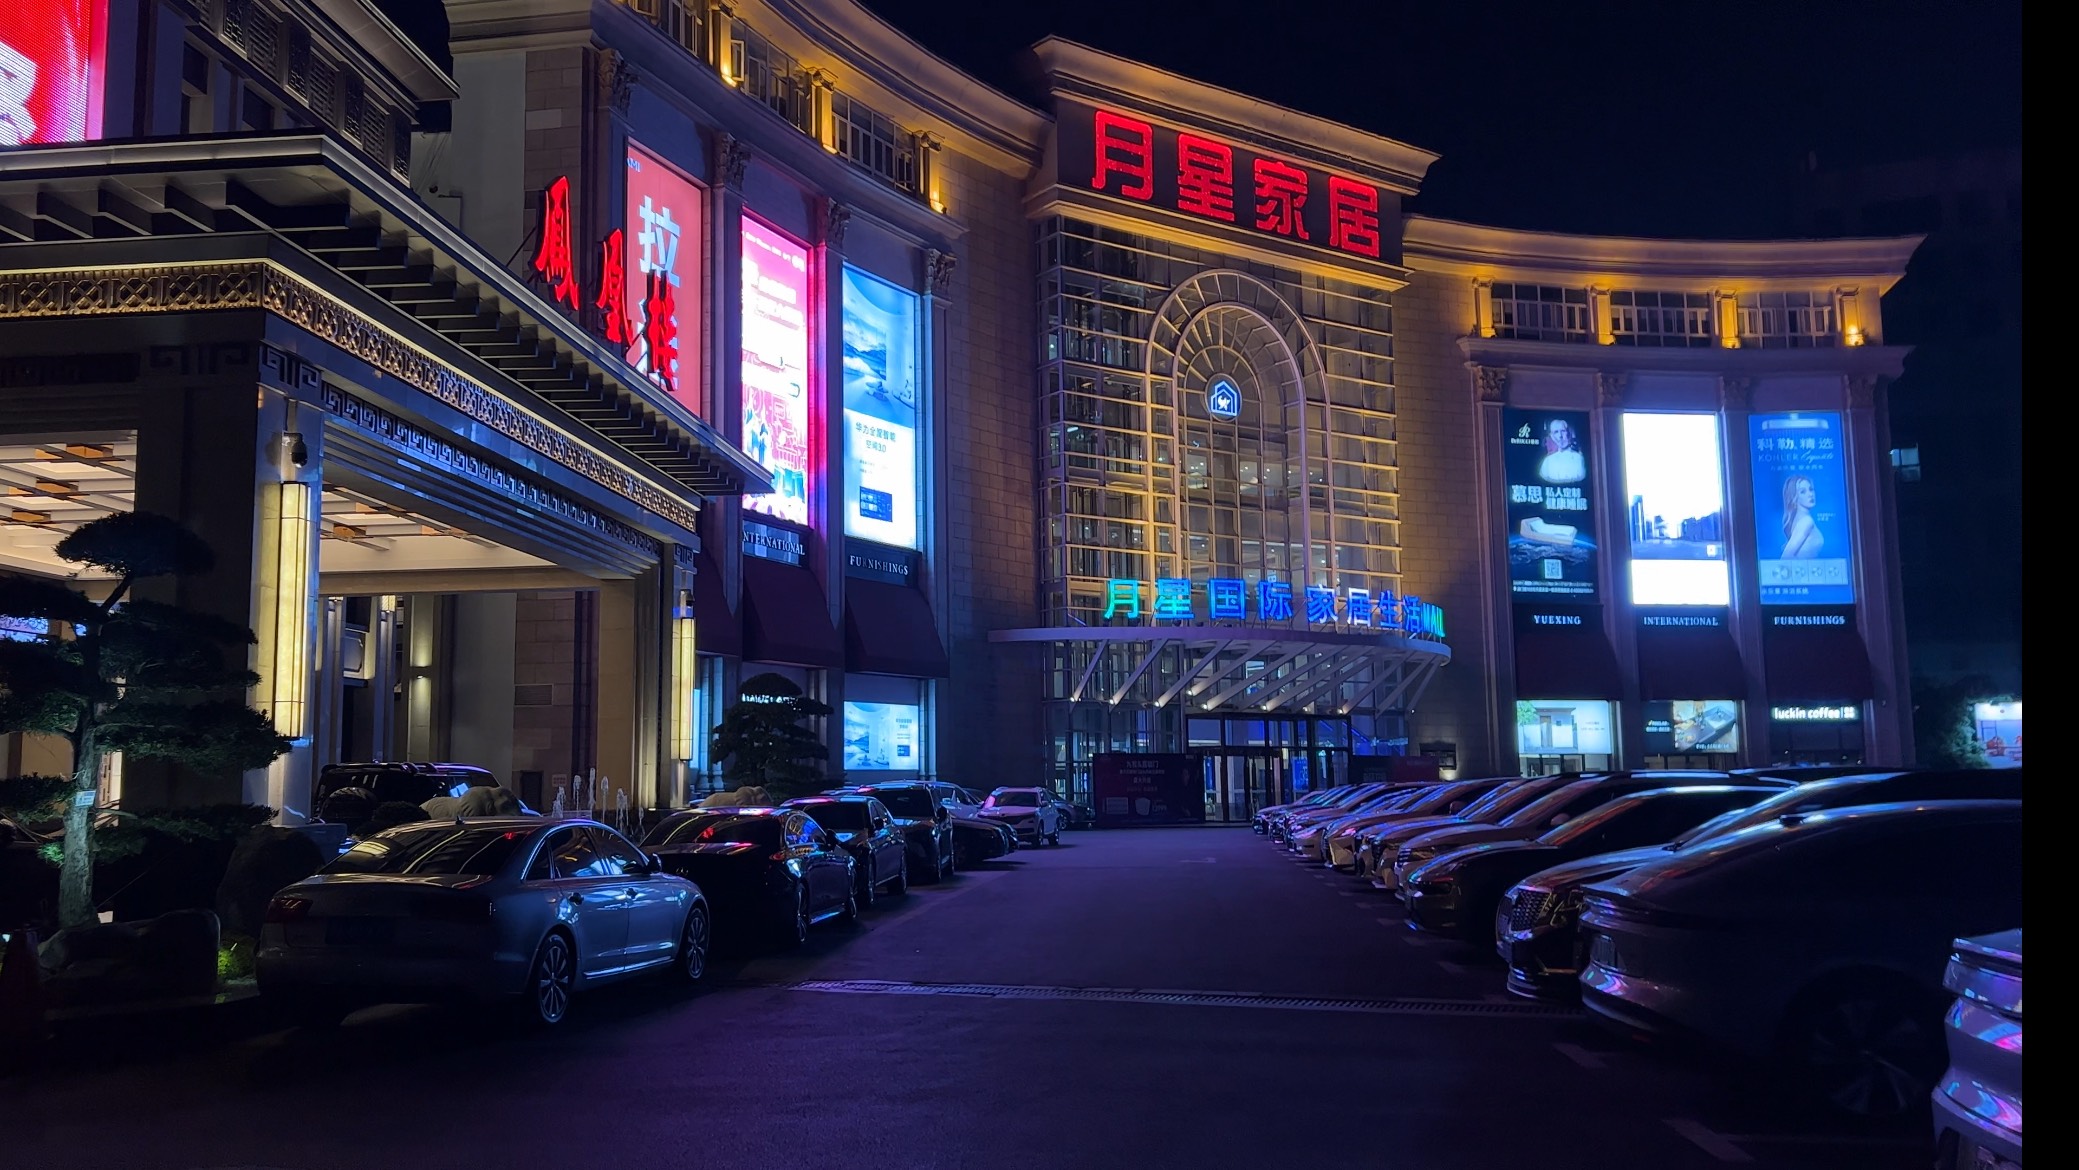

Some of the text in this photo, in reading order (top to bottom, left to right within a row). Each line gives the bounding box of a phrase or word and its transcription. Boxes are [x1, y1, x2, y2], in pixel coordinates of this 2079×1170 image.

[1092, 110, 1380, 258] 月星家居
[1511, 484, 1543, 503] 慕思
[741, 530, 806, 556] NTERNATIONAL
[849, 554, 909, 576] FURNISHINGS
[1533, 614, 1581, 625] YUEXING
[1643, 616, 1719, 627] INTERNATIONAL
[1773, 615, 1845, 626] FURNISHINGS
[1774, 706, 1806, 719] luckin
[1807, 706, 1840, 719] coffee
